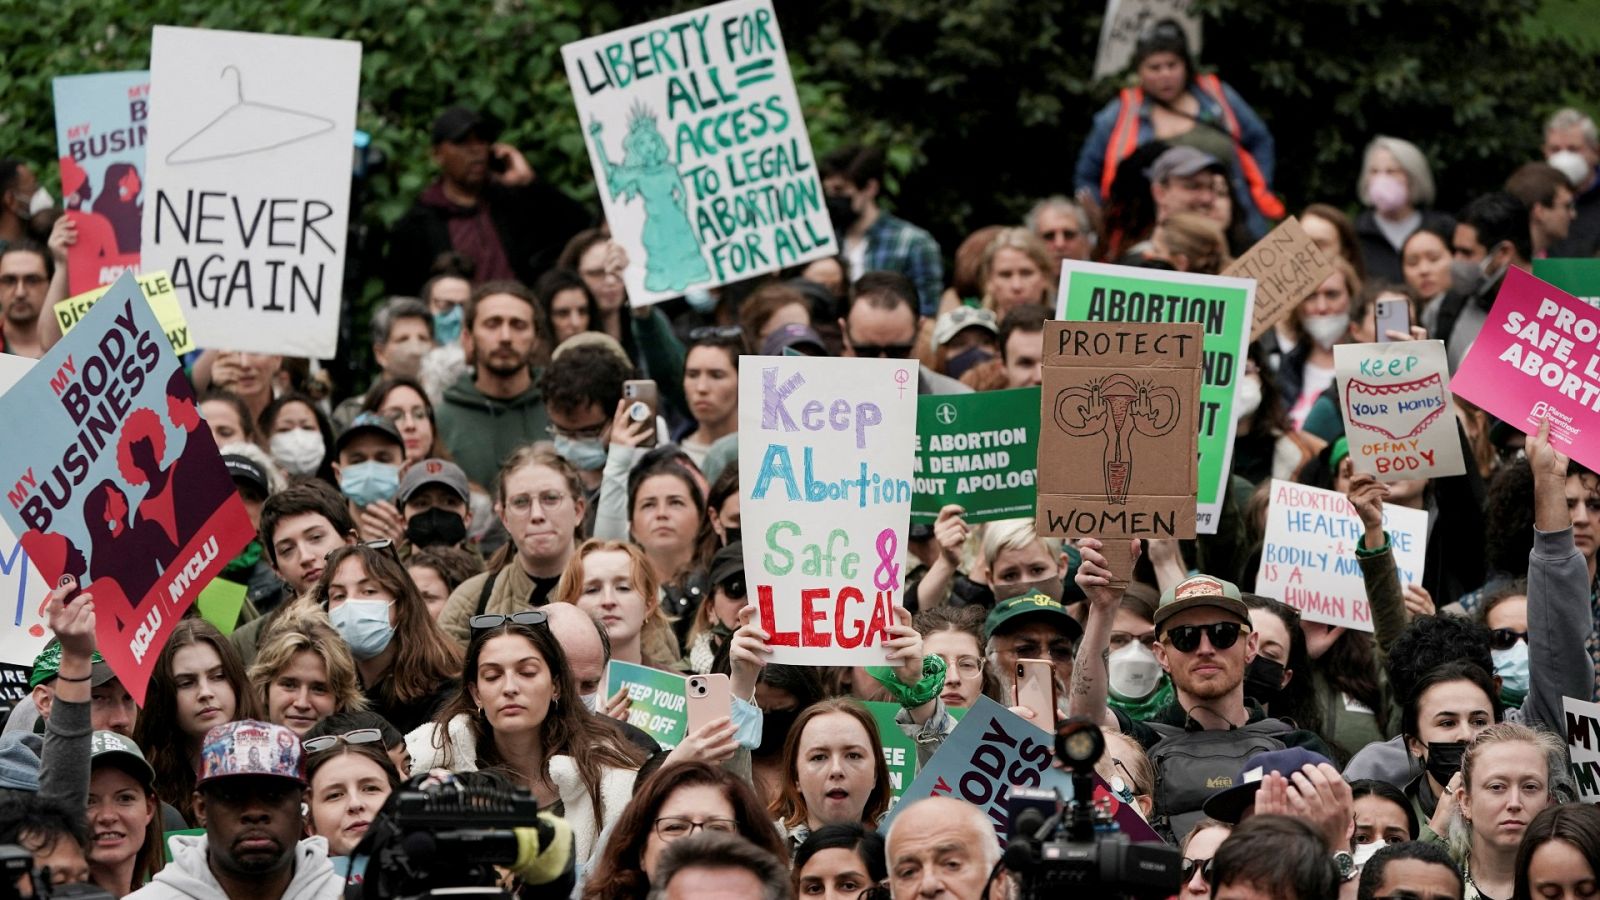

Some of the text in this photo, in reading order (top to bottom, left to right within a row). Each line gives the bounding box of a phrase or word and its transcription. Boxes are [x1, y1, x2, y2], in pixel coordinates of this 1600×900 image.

[577, 8, 776, 95] LIBERTY FOR
[667, 67, 739, 119] ALL
[67, 122, 90, 139] MY
[675, 95, 790, 164] ACCESS
[683, 138, 810, 201] TO LEGAL
[154, 188, 337, 255] NEVER
[696, 178, 821, 244] ABORTION
[709, 220, 829, 282] FOR ALL
[171, 254, 325, 316] AGAIN
[1087, 287, 1225, 336] ABORTION
[61, 299, 139, 426] BODY
[1059, 329, 1193, 358] PROTECT
[1502, 311, 1579, 370] SAFE,
[49, 354, 77, 396] MY
[761, 367, 884, 449] Keep
[1352, 402, 1388, 417] YOUR
[1545, 412, 1582, 436] Parenthood
[1548, 405, 1574, 424] Planned
[19, 330, 160, 533] BUSINESS
[929, 427, 1028, 453] ABORTION
[751, 443, 911, 509] Abortion
[930, 451, 1010, 474] DEMAND
[1375, 449, 1435, 474] BODY
[7, 467, 38, 509] MY
[1047, 510, 1176, 536] WOMEN
[763, 520, 901, 592] Safe &
[1264, 564, 1303, 585] IS A
[1266, 542, 1328, 572] BODILY
[129, 535, 219, 665] ACLU NYCLU
[1284, 586, 1346, 618] HUMAN
[652, 689, 686, 713] YOUR
[648, 715, 677, 735] OFF
